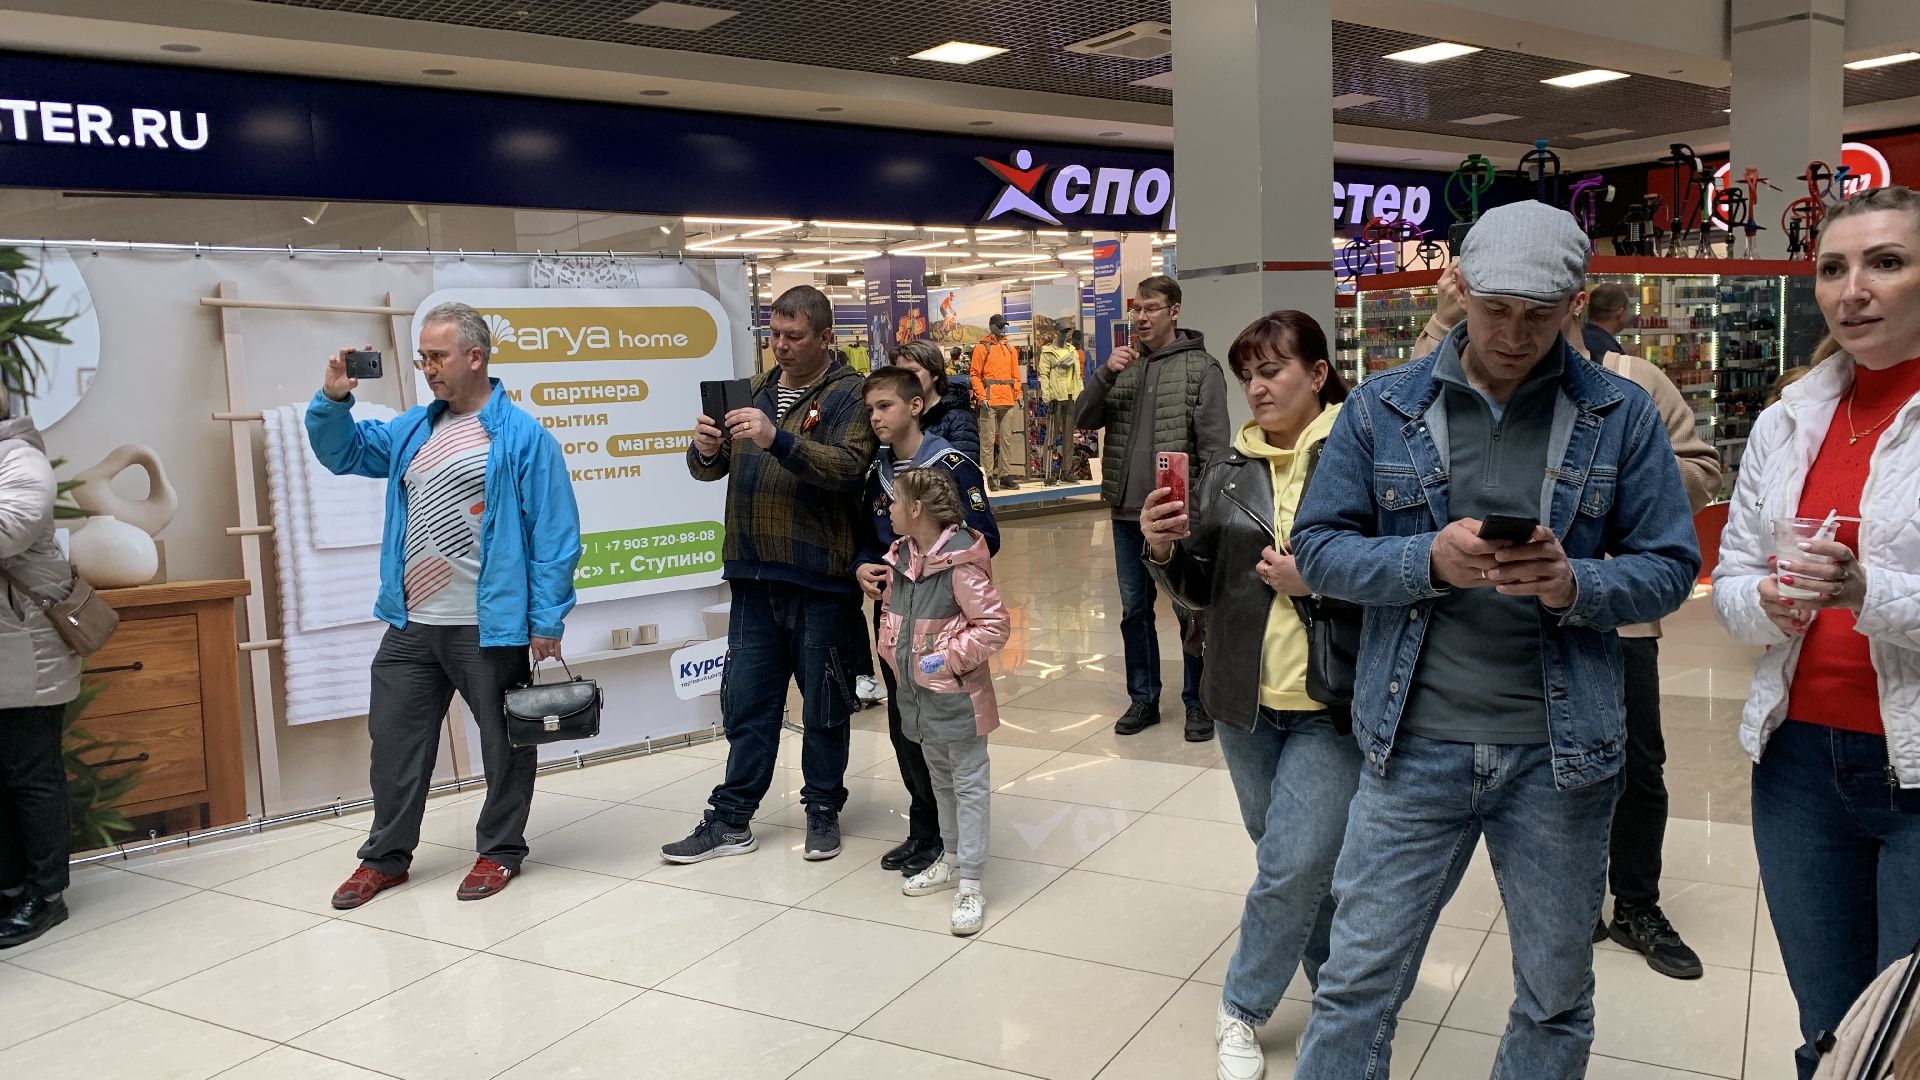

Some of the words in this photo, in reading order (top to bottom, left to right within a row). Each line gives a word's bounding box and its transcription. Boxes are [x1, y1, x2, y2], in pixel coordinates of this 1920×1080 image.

[0, 99, 209, 150] TER.RU
[517, 326, 610, 356] arya
[618, 329, 689, 348] home
[543, 383, 640, 403] партнера
[537, 413, 609, 430] рытия
[560, 441, 599, 455] ого
[571, 465, 641, 482] кстиля
[605, 540, 621, 552] +7
[623, 537, 649, 551] 903
[651, 529, 716, 548] 720-98-08
[610, 561, 625, 576] г.
[630, 550, 716, 574] Ступино
[680, 655, 724, 679] Курс
